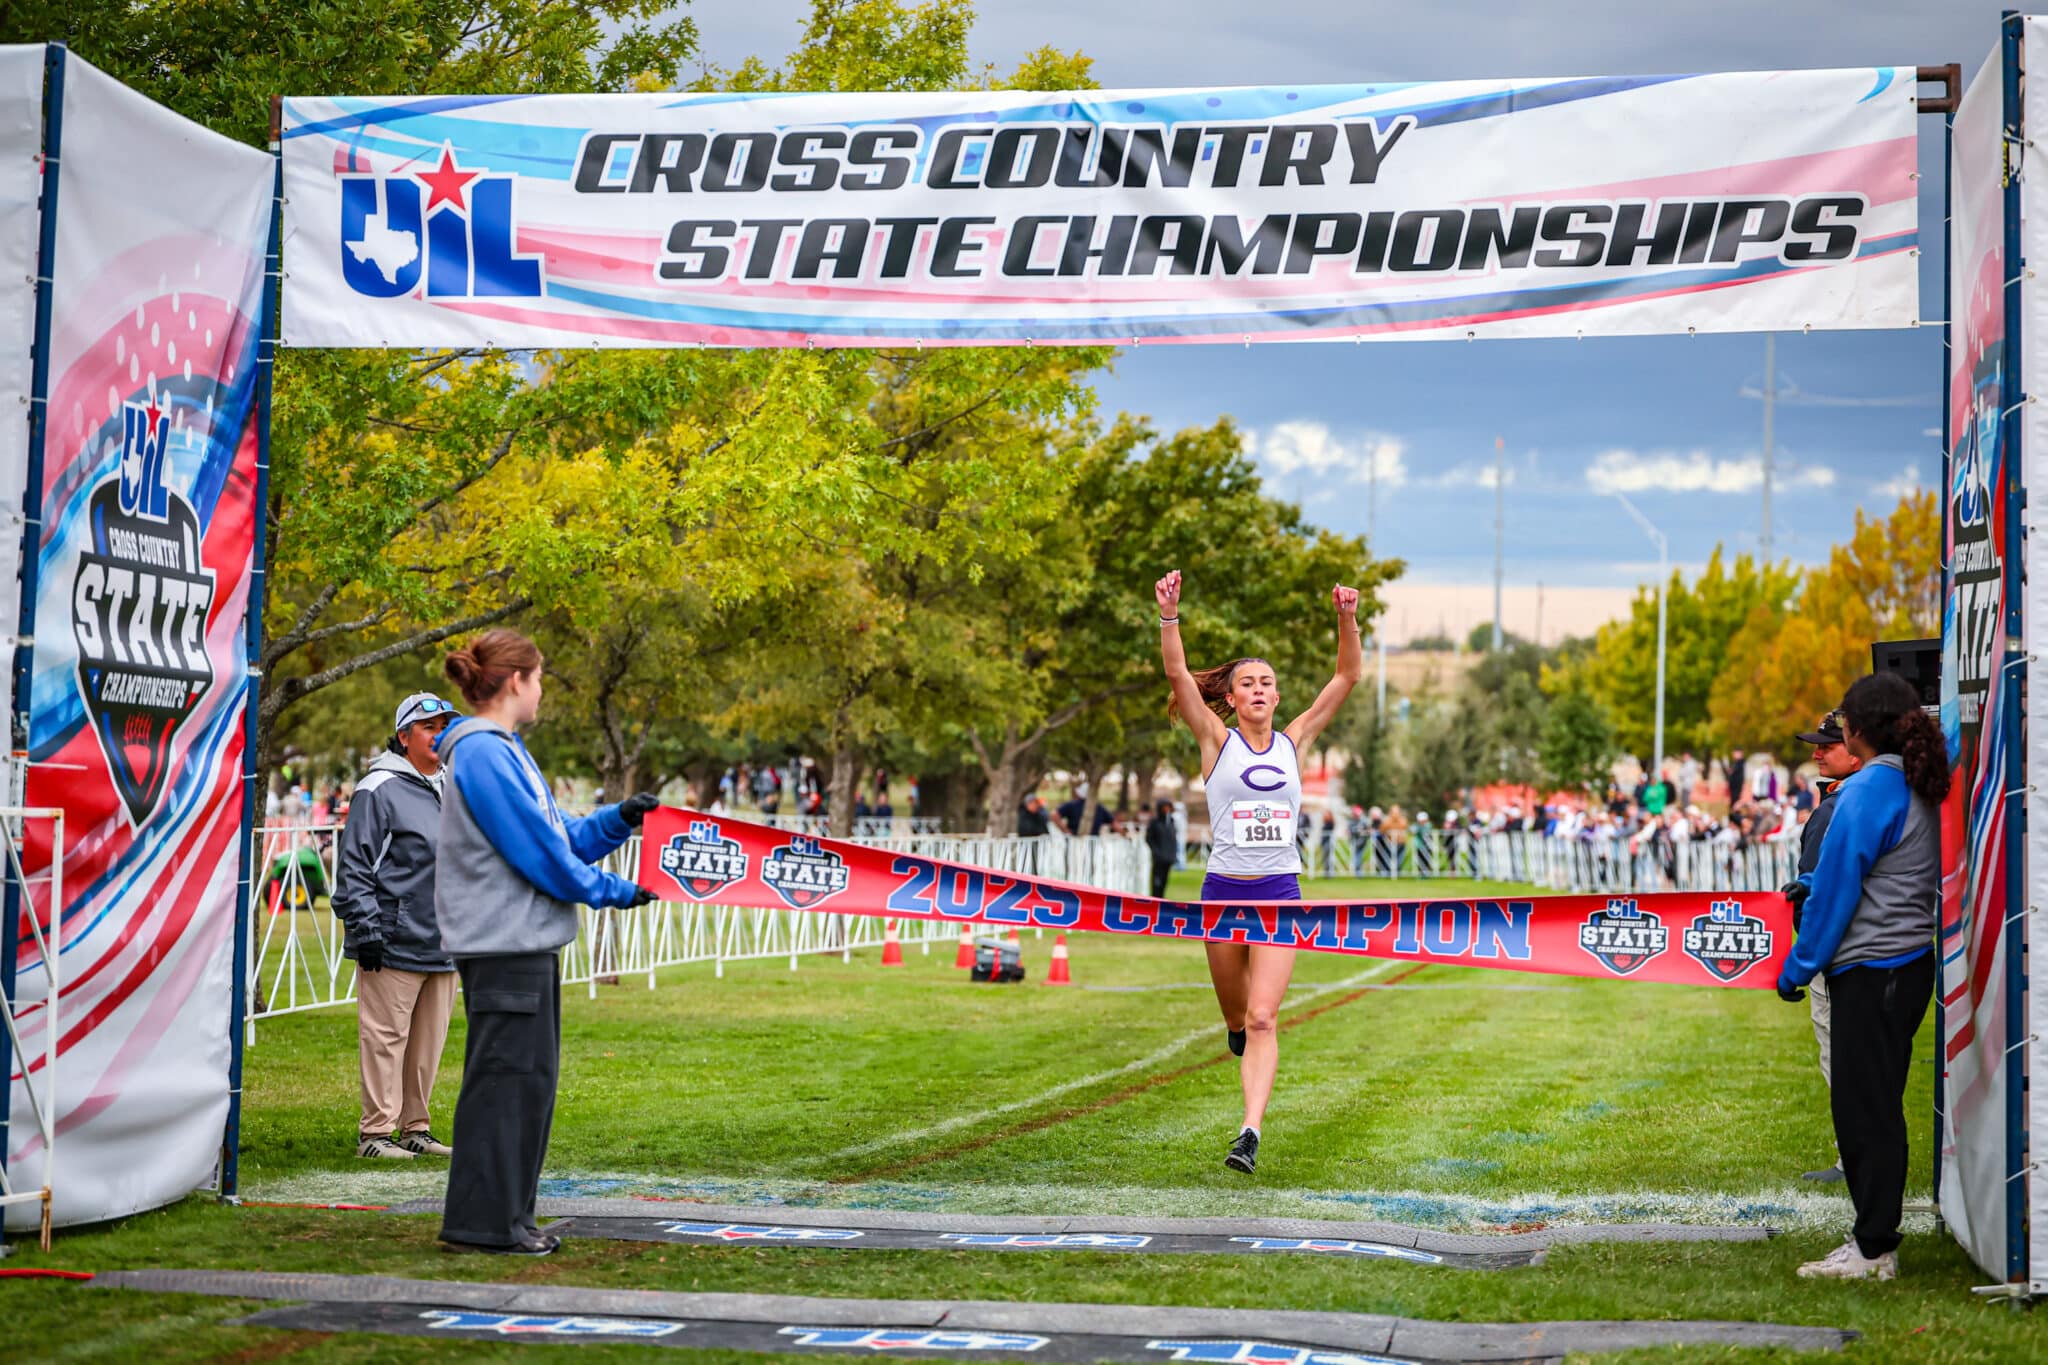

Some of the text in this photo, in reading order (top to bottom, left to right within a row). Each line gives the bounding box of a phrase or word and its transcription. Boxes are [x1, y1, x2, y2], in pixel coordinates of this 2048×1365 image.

[573, 117, 1413, 194] CROSS COUNTRY
[659, 196, 1866, 280] STATE CHAMPIONSHIPS
[109, 527, 181, 569] CROSS COUNTRY
[75, 561, 211, 673] STATE
[101, 671, 188, 710] CHAMPIONSHIPS
[1240, 764, 1288, 792] C
[1245, 825, 1283, 842] 1911
[663, 848, 745, 877] STATE
[764, 860, 847, 888] STATE
[887, 856, 1533, 960] 2025 CHAMPION
[1582, 926, 1665, 948] STATE
[1686, 930, 1769, 953] STATE
